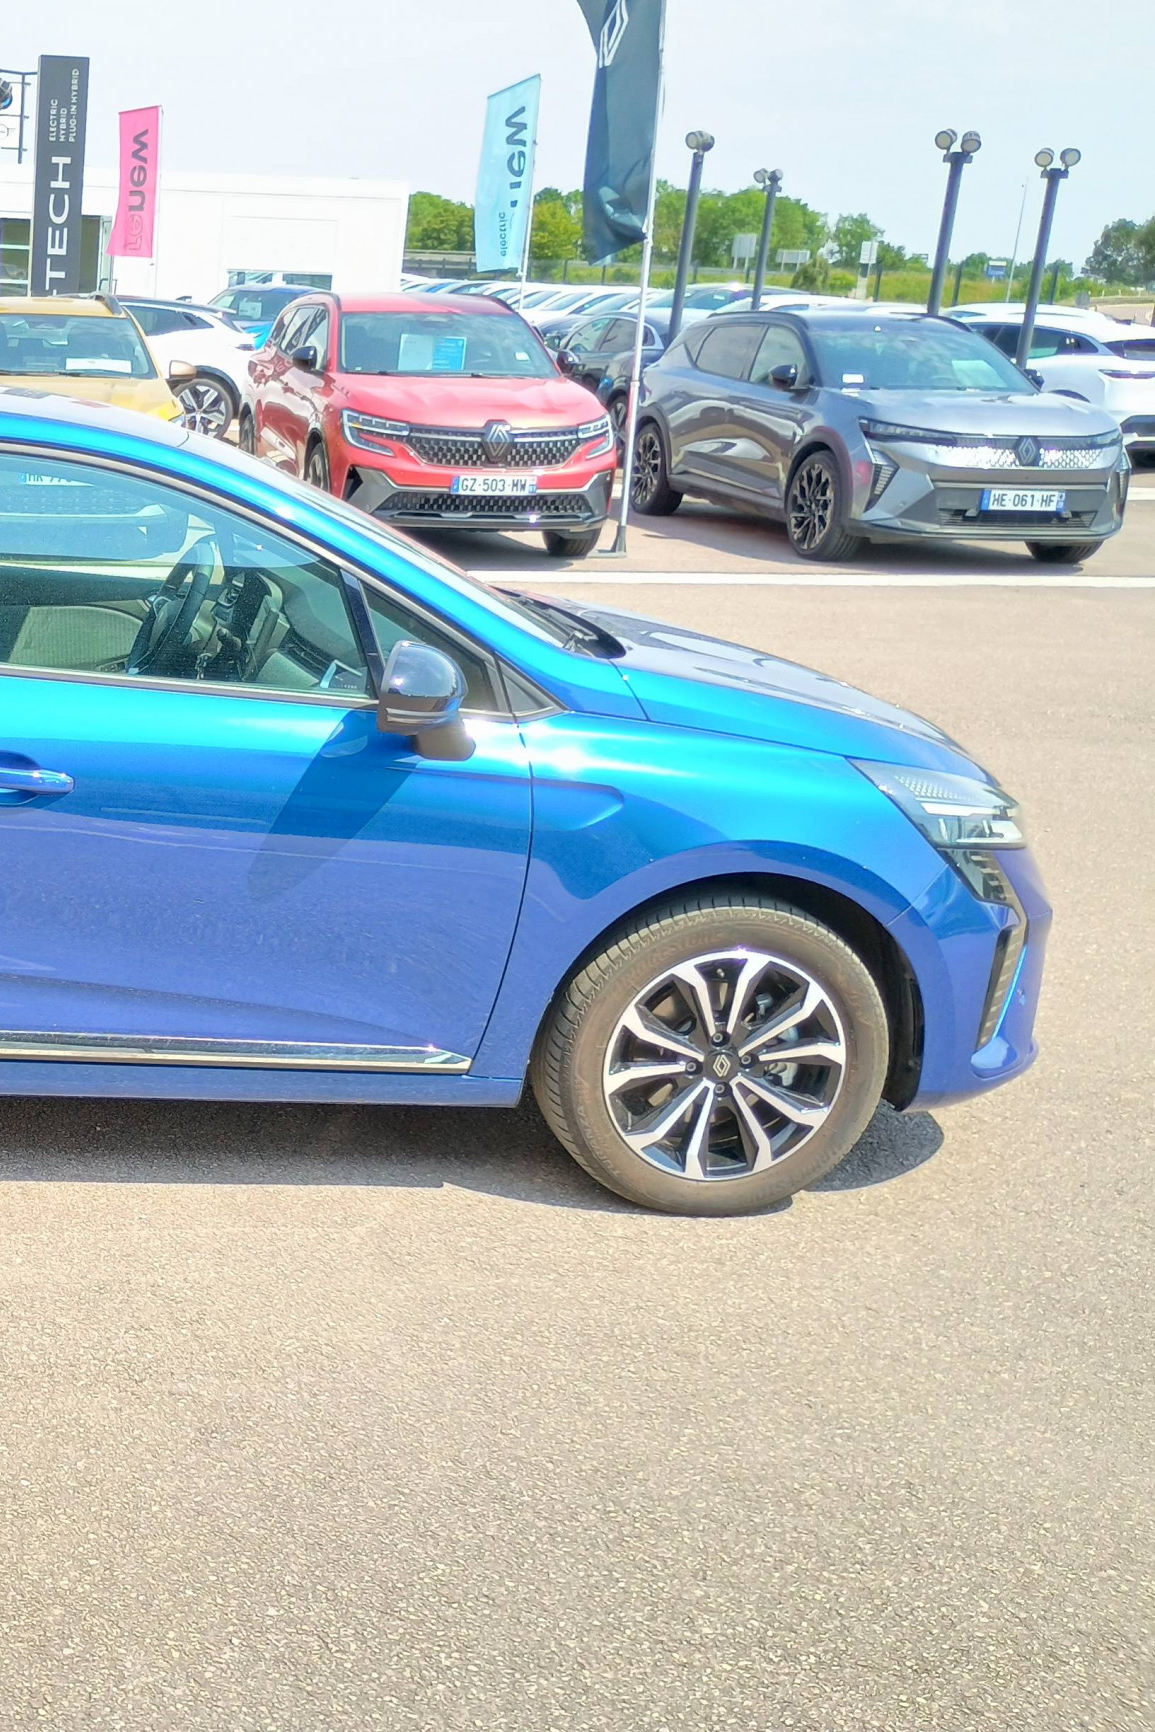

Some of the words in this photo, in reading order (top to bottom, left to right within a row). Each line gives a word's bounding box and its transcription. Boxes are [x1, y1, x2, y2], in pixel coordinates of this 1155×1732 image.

[71, 68, 80, 103] HYBRID
[49, 98, 58, 142] ELECTRIC
[59, 107, 68, 142] HYBRID
[68, 104, 77, 143] PLUG-IN
[991, 493, 1056, 508] HE-061-HF
